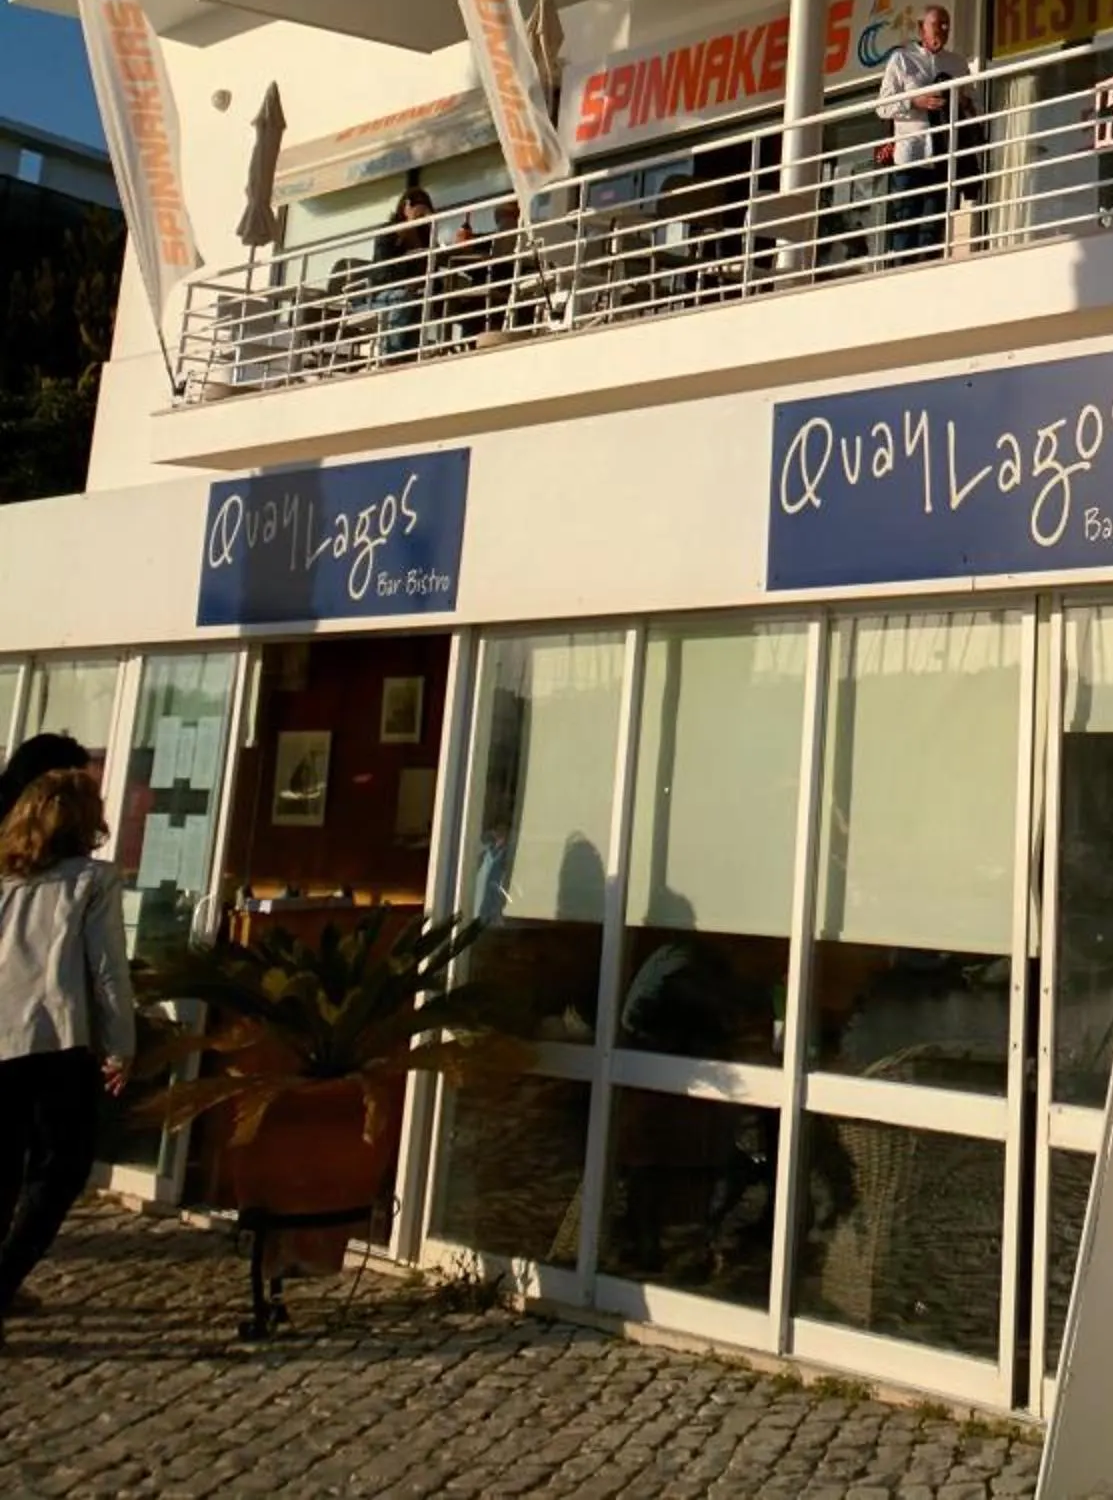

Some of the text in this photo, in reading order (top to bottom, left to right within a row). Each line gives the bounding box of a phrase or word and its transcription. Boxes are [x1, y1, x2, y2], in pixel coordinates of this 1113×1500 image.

[102, 0, 190, 267] SPINNAKERS
[304, 473, 418, 600] Lagos
[377, 567, 451, 596] Bar Bistro
